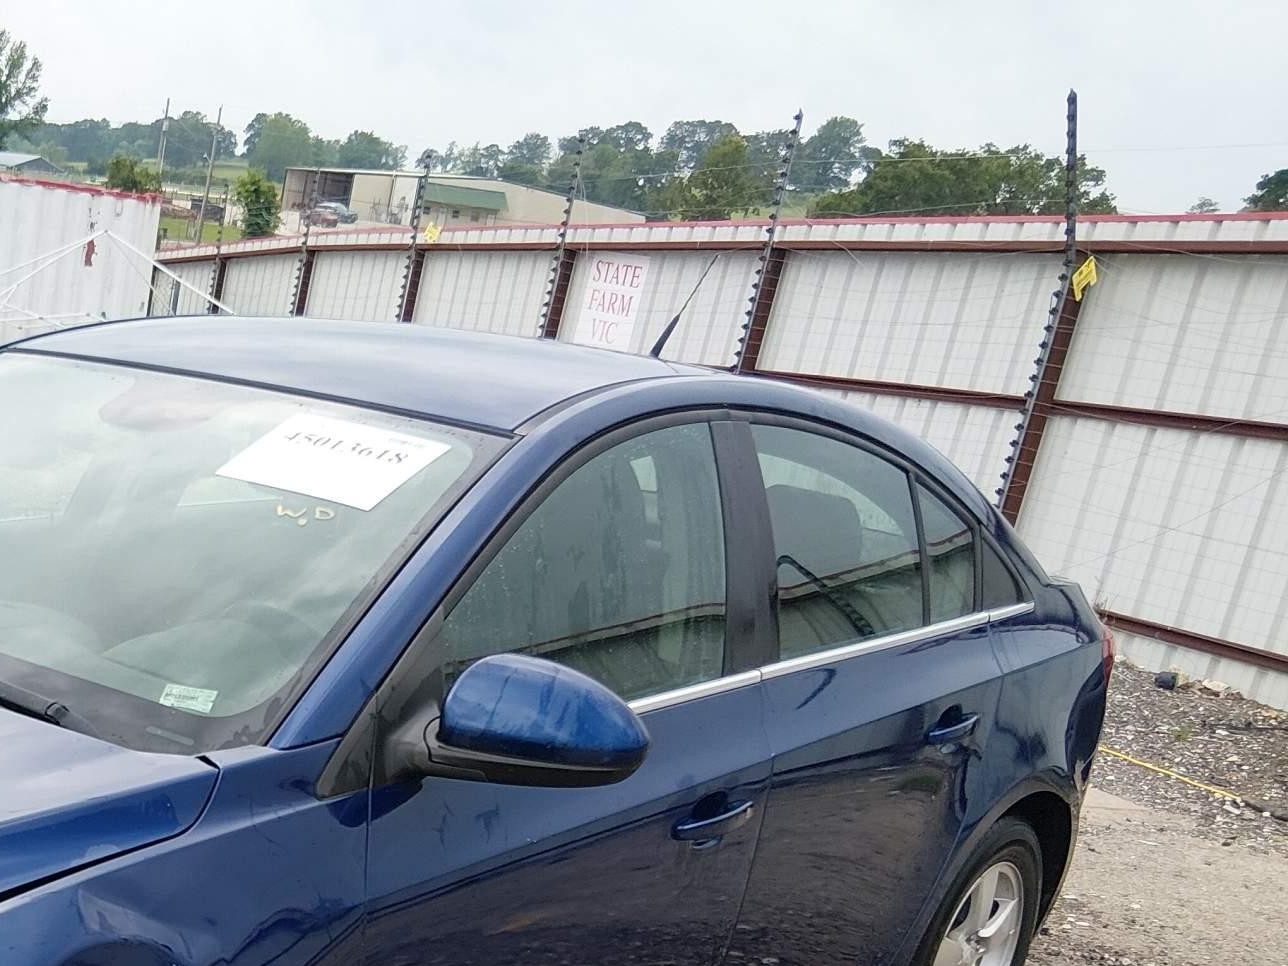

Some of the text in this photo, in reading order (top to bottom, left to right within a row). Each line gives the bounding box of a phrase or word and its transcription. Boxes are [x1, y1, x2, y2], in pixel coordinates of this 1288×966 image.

[593, 260, 643, 288] STATE
[588, 289, 634, 317] FARM
[592, 318, 618, 344] VIC
